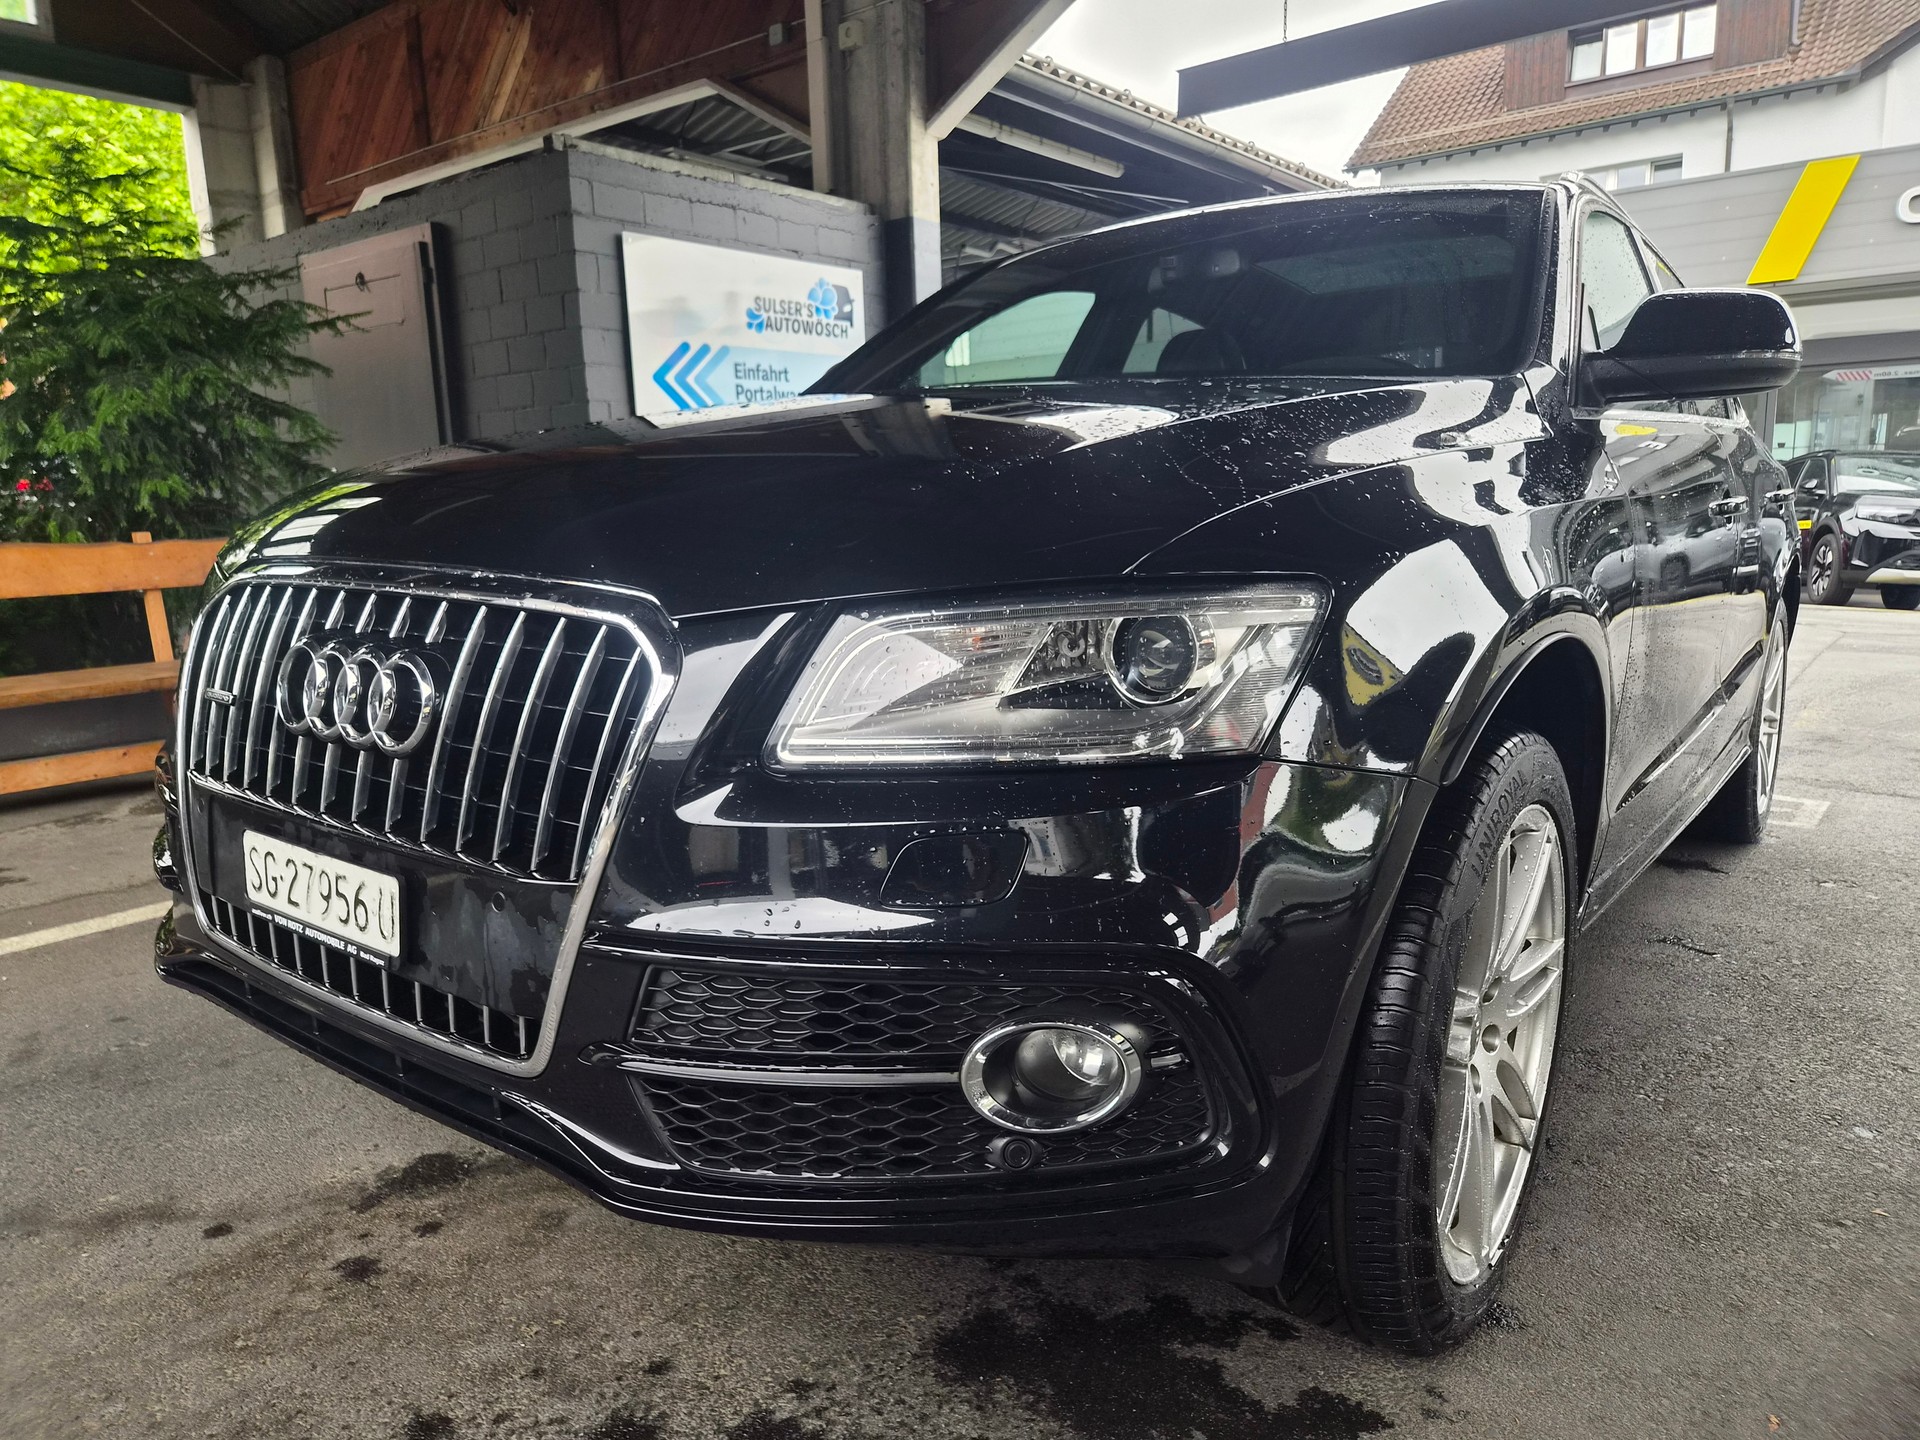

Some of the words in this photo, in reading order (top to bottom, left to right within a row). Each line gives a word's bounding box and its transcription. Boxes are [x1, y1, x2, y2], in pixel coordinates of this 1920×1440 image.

[754, 296, 814, 318] SULSER'S
[765, 316, 848, 338] AUTOWÖSCH
[734, 362, 790, 383] Einfahrt
[305, 927, 345, 950] AUTOMOBILE
[347, 943, 357, 955] AG
